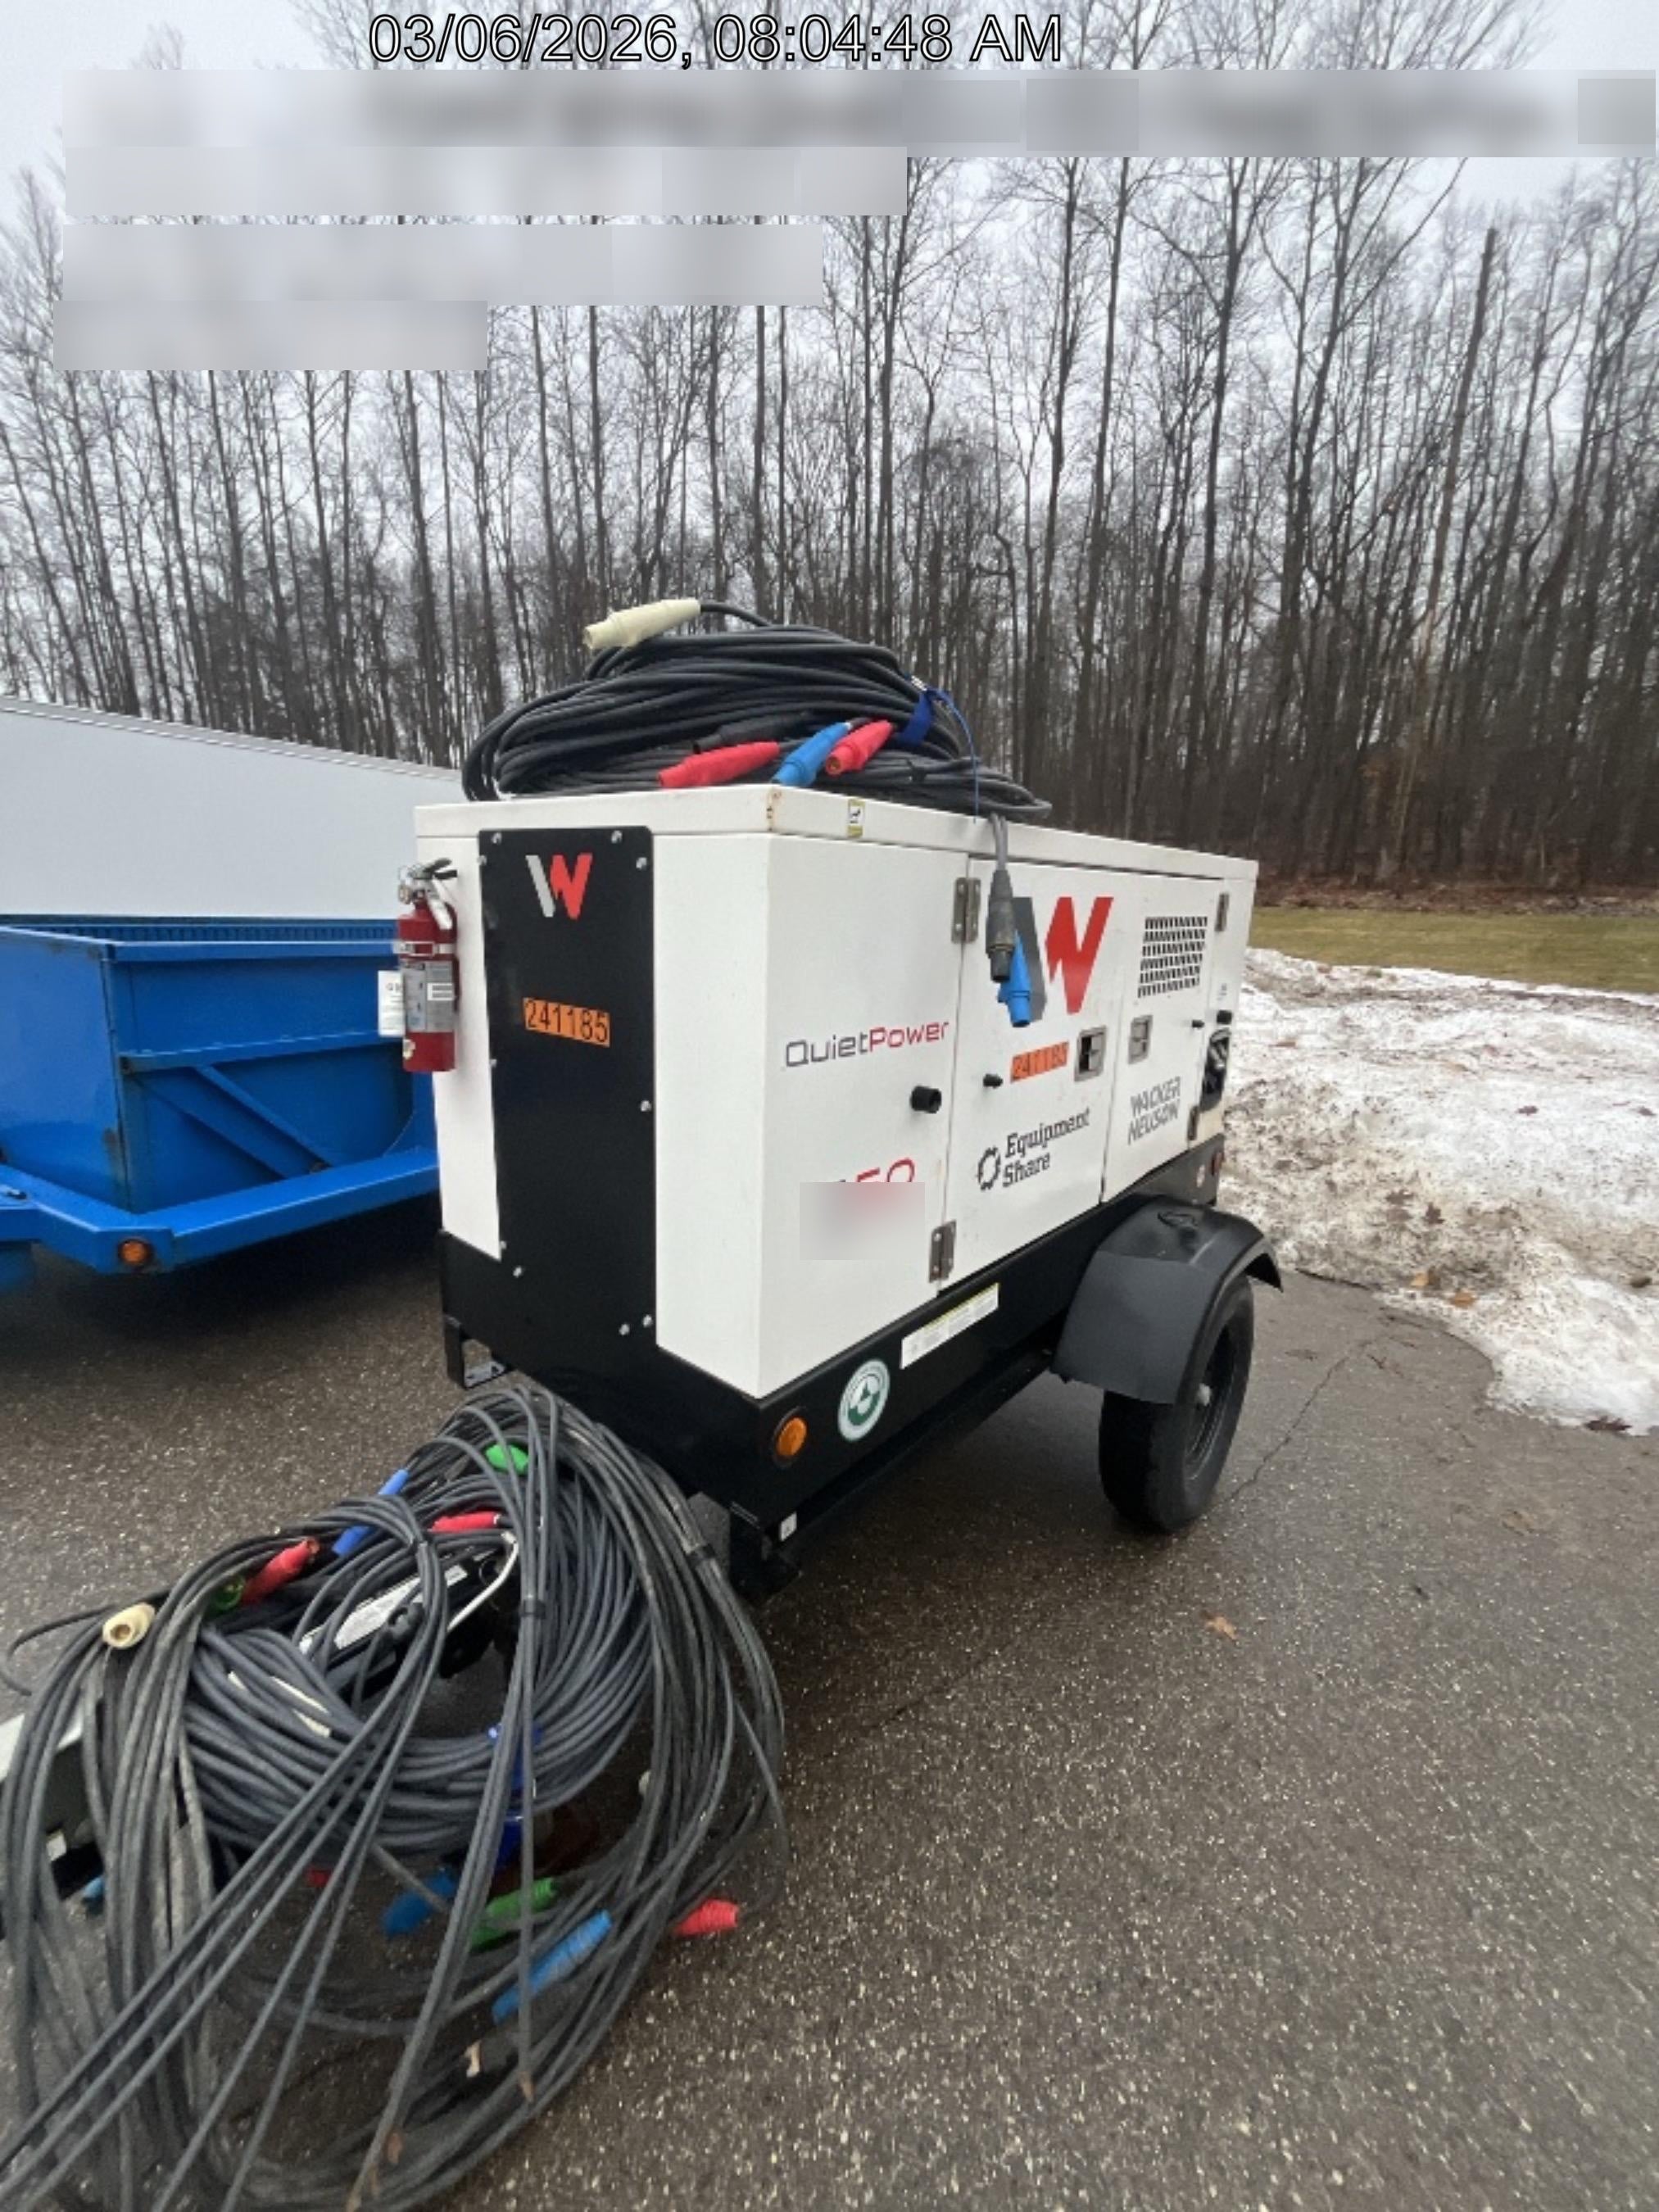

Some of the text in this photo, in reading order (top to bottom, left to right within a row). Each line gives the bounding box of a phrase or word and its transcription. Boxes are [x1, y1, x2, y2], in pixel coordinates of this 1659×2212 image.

[524, 999, 609, 1044] 241185
[785, 1022, 950, 1067] QuietPower
[1130, 1076, 1181, 1118] WACKER
[1004, 1106, 1090, 1158] Equipment
[1127, 1098, 1180, 1145] NEUSON
[1002, 1152, 1051, 1188] Share
